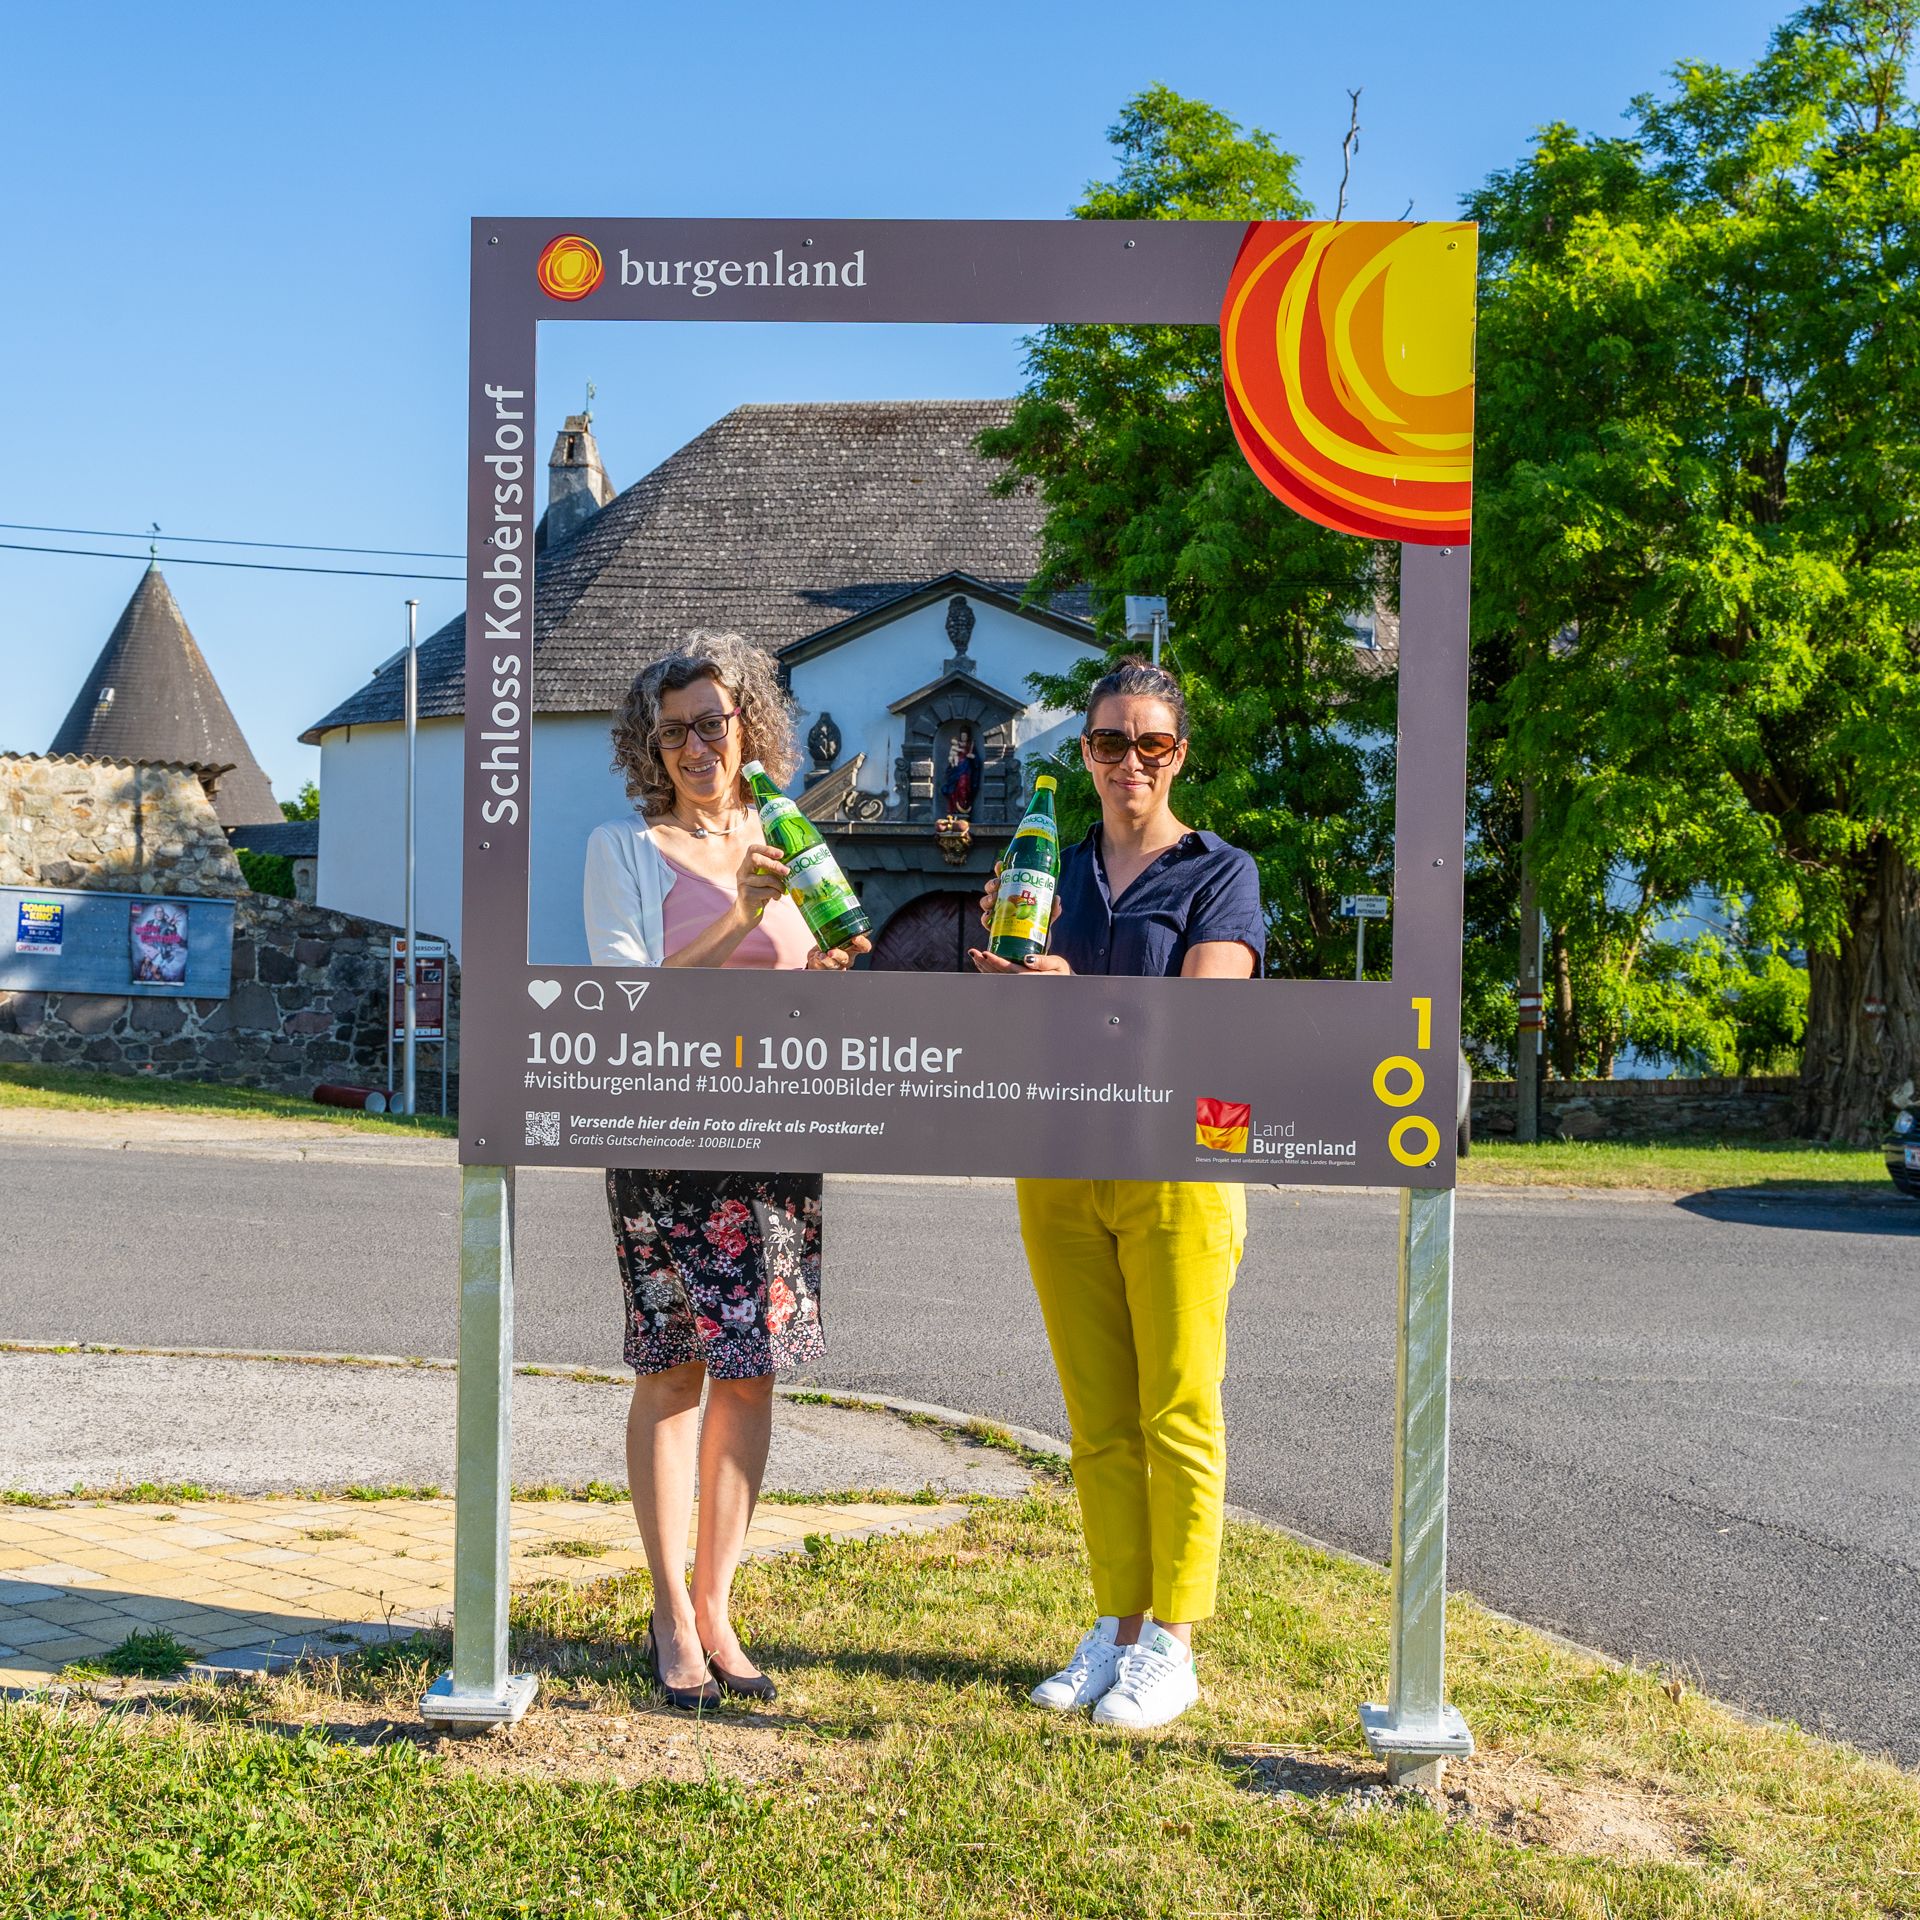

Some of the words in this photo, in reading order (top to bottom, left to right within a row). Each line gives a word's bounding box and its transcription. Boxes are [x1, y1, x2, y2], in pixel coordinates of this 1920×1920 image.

[619, 249, 867, 297] burgenland
[483, 383, 524, 640] Kobersdorf
[480, 654, 521, 826] Schloss
[526, 1031, 597, 1066] 100
[607, 1032, 722, 1068] Jahre
[757, 1036, 828, 1071] 100
[841, 1036, 963, 1074] Bilder
[523, 1070, 690, 1096] #visitburgenland
[695, 1075, 896, 1097] #100Jahre100Bilder
[899, 1079, 1021, 1100] #wirsind100
[1025, 1082, 1174, 1103] #wirsindkultur
[569, 1115, 635, 1130] Versende
[637, 1116, 667, 1130] hier
[669, 1117, 700, 1131] dein
[703, 1118, 736, 1132] Foto
[738, 1118, 783, 1133] direkt
[784, 1119, 806, 1134] als
[808, 1120, 885, 1136] Postkarte!
[569, 1133, 604, 1146] Gratis
[606, 1134, 696, 1148] Gutscheincode:
[697, 1136, 762, 1150] 100BILDER
[1253, 1120, 1295, 1137] Land
[1253, 1138, 1357, 1159] Burgenland
